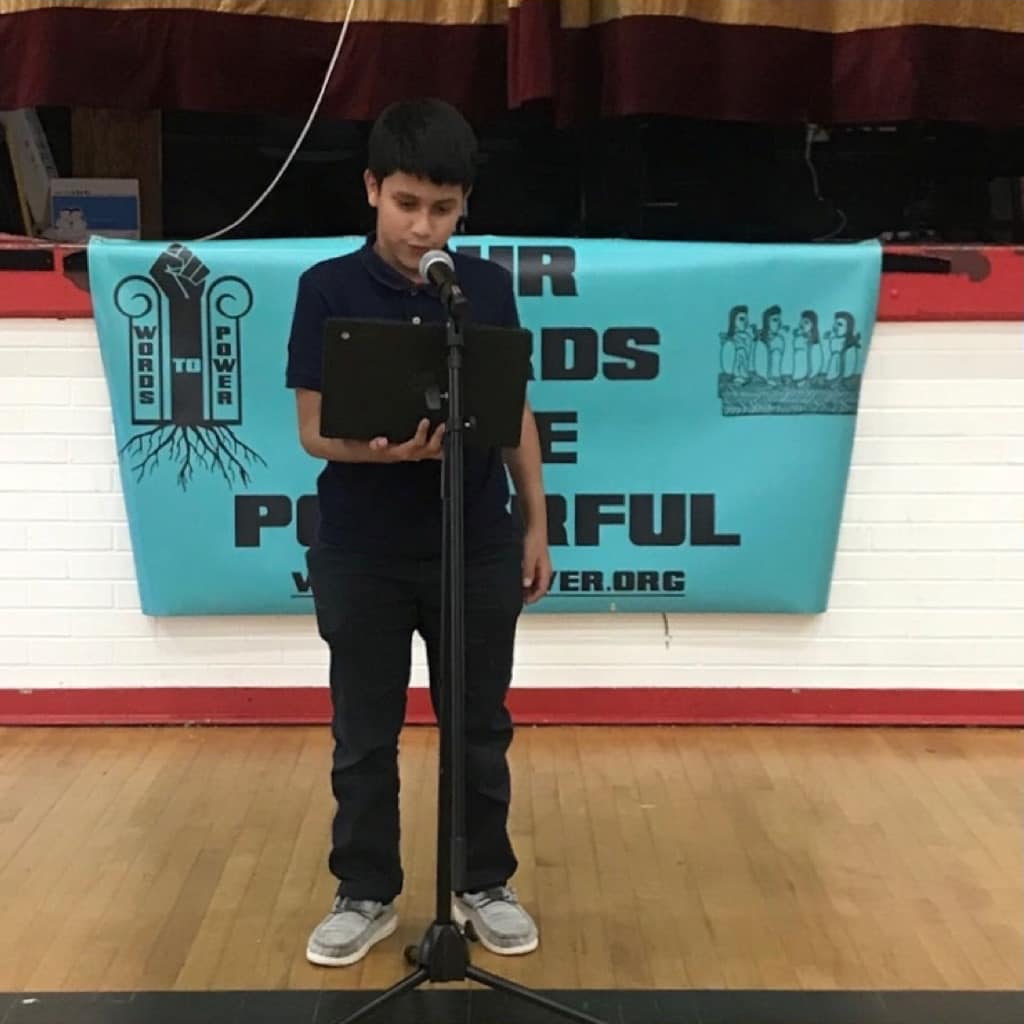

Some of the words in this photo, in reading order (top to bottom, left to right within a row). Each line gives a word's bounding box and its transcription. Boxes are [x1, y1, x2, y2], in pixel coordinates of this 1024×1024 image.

[134, 326, 156, 405] WORDS
[172, 357, 201, 374] TO
[212, 326, 236, 405] POWER
